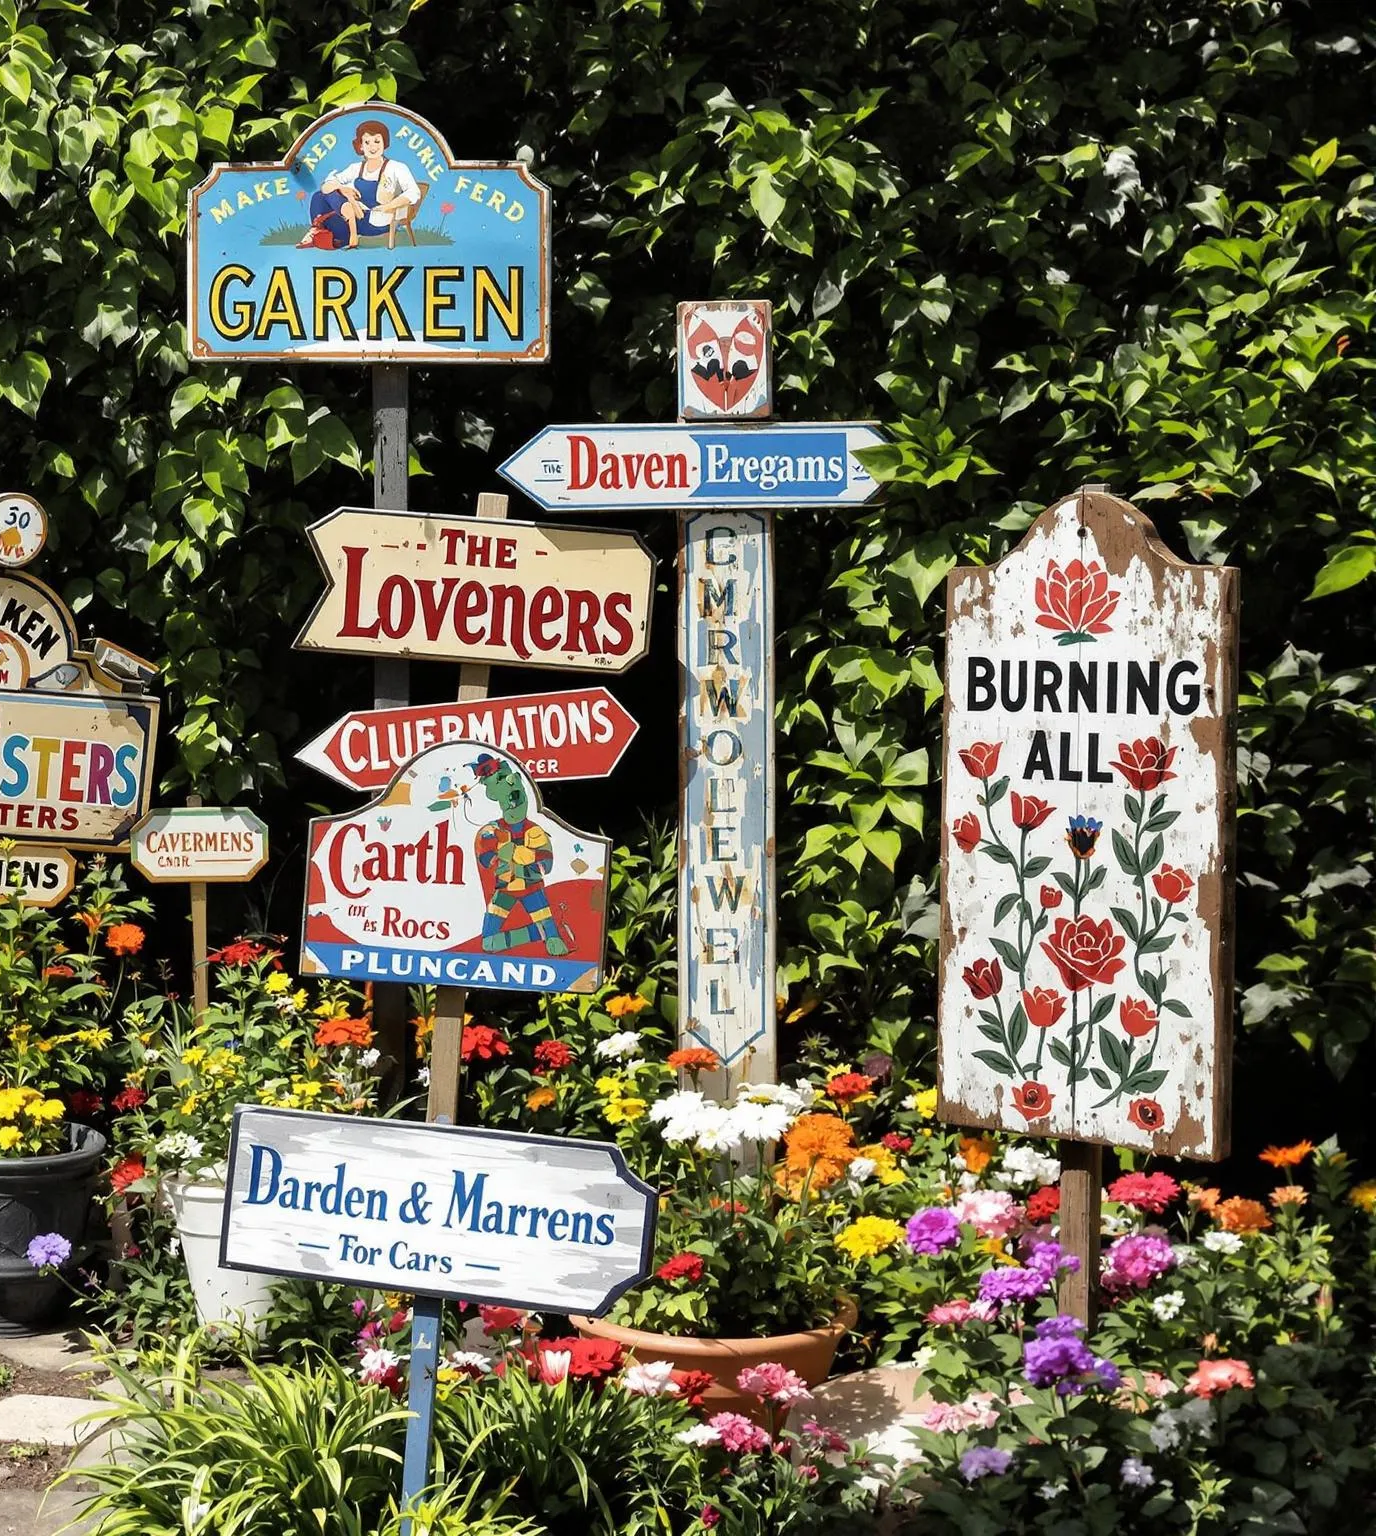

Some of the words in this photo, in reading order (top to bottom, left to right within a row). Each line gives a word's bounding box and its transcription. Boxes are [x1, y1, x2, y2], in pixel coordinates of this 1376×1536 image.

[209, 176, 291, 225] MAKE
[453, 175, 526, 223] FERD
[208, 264, 525, 342] GARKEN
[566, 435, 690, 491] Daven
[705, 444, 844, 490] Eregams
[439, 529, 518, 569] THE
[966, 656, 1201, 716] BURNING
[1022, 730, 1114, 784] ALL
[146, 831, 255, 854] CAVERMENS
[328, 819, 466, 899] Carth
[381, 906, 451, 941] Rocs
[340, 948, 557, 986] PLUNCAND
[242, 1144, 388, 1222] Darden
[399, 1181, 433, 1225] &
[442, 1169, 616, 1246] Marrens
[338, 1233, 382, 1266] For
[388, 1241, 453, 1274] Cars
